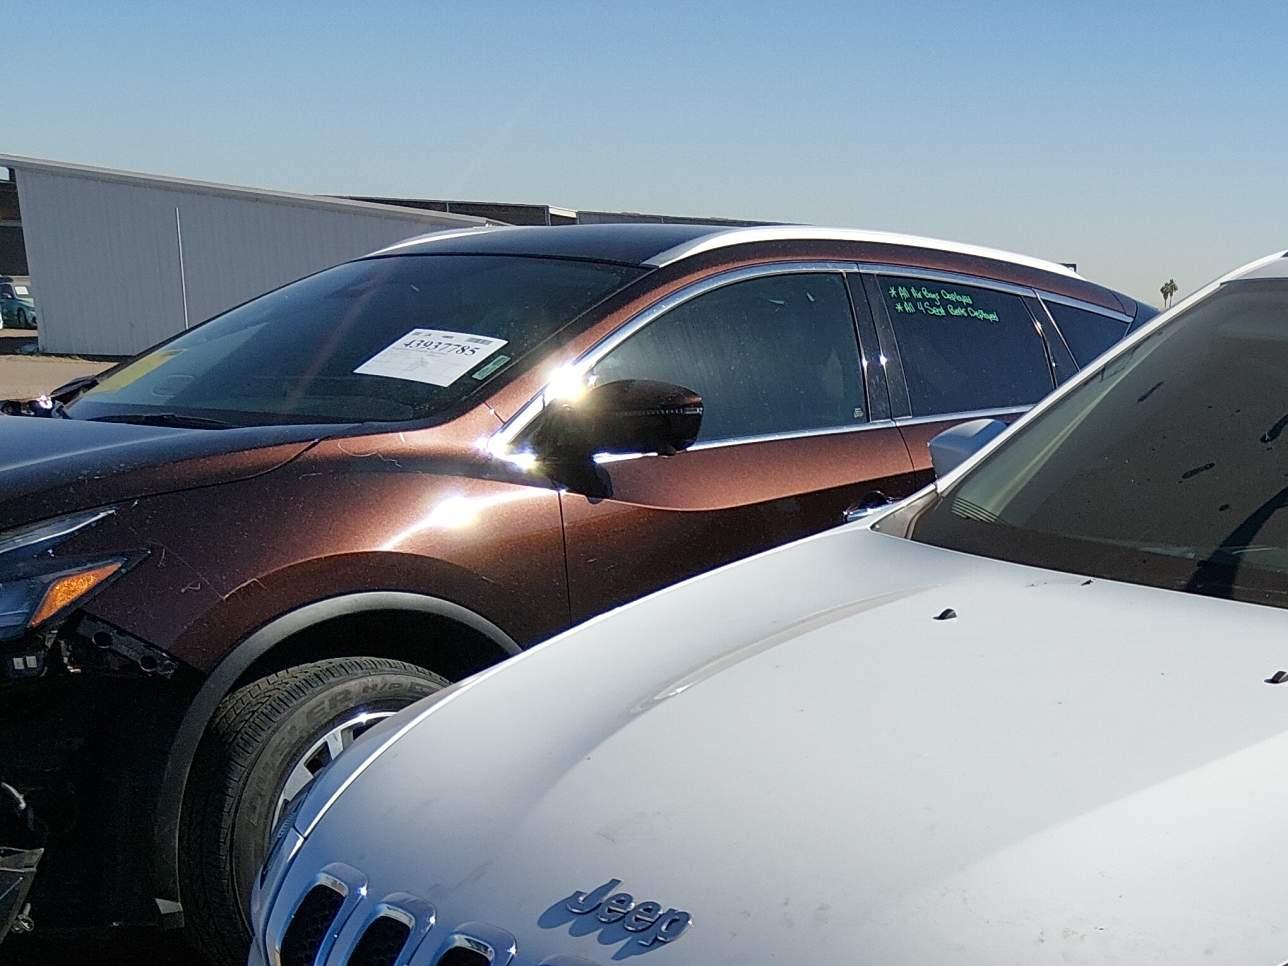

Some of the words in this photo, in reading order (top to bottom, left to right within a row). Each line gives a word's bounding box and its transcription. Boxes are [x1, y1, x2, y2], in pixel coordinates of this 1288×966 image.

[917, 302, 926, 314] 4
[404, 339, 480, 356] 43937785
[567, 878, 692, 946] Jeep
